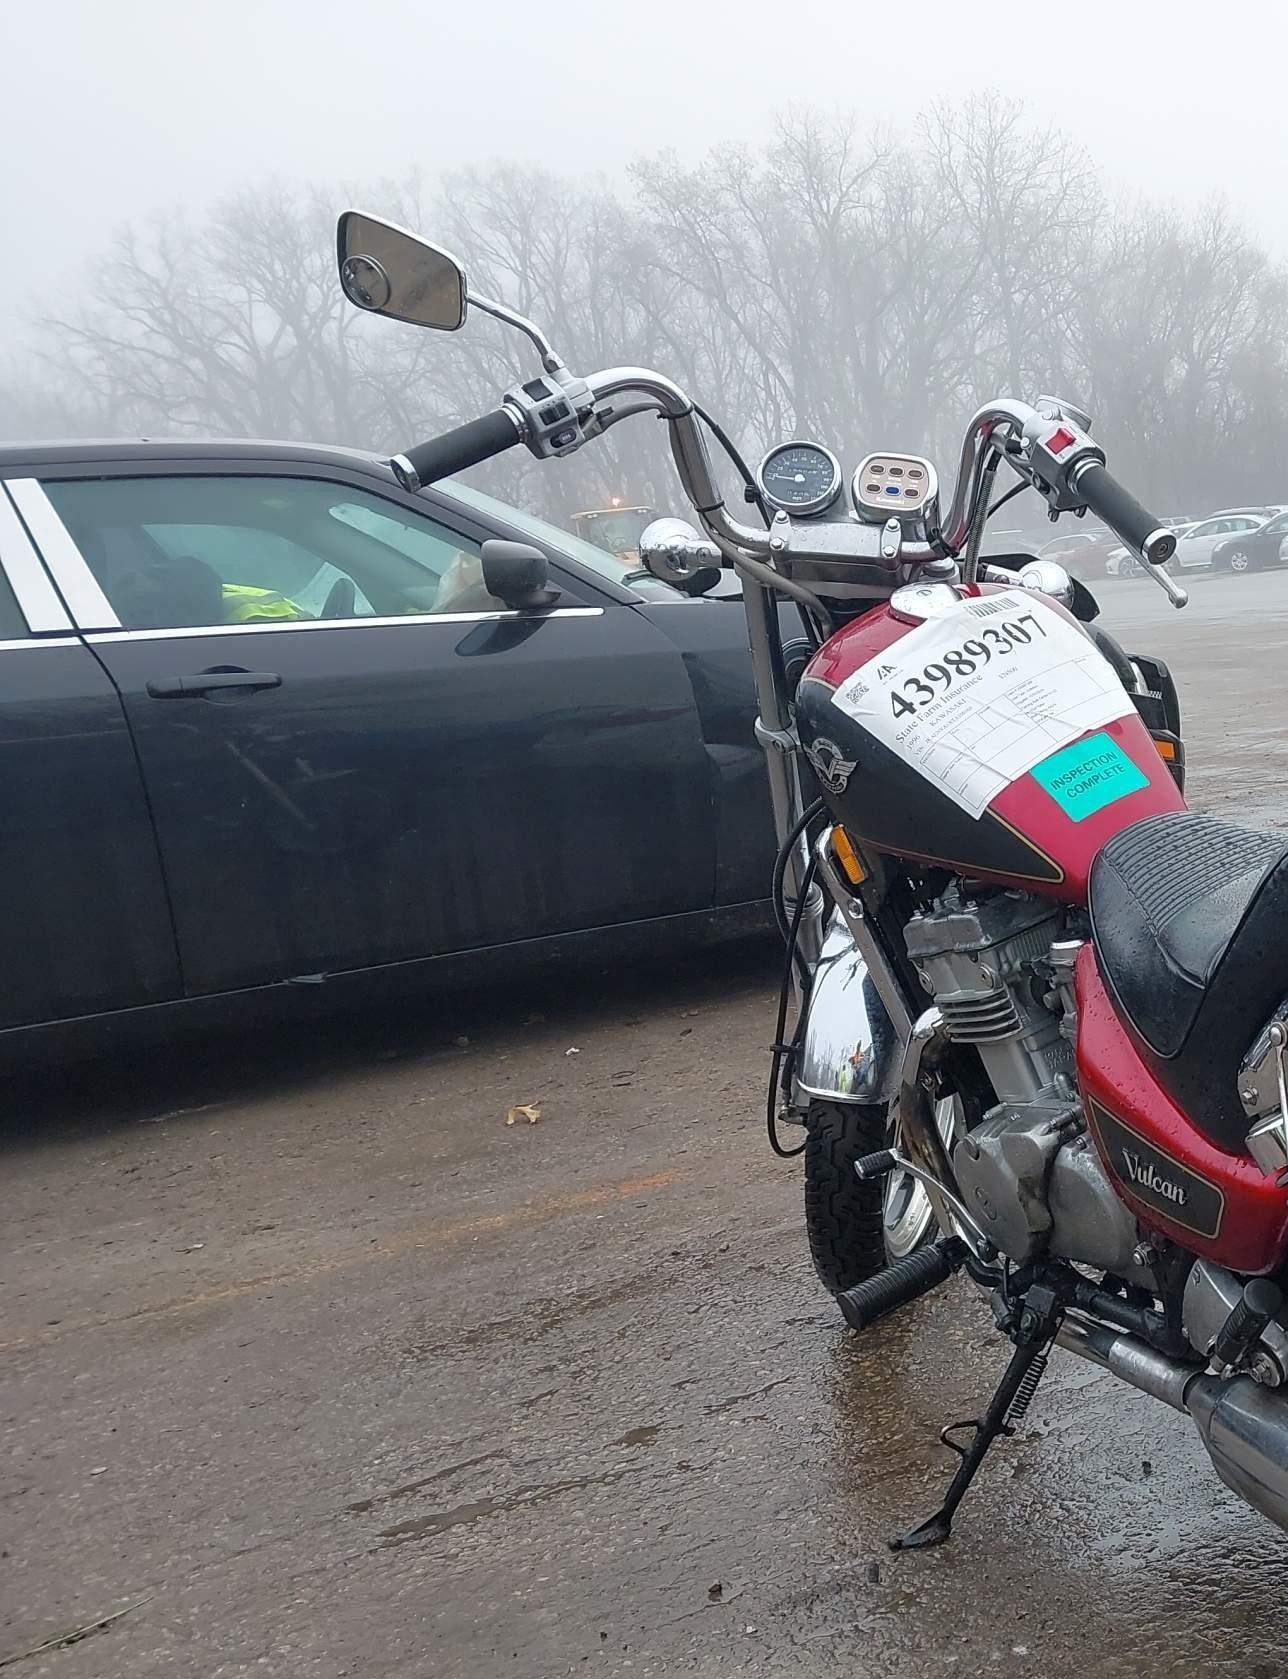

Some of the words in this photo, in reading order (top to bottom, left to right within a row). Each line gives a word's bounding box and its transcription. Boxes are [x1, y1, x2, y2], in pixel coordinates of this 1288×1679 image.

[890, 614, 1047, 720] 43989307
[895, 719, 919, 744] State
[917, 701, 942, 722] Farm
[939, 674, 983, 704] Insurance
[929, 698, 967, 727] KAWASAKI
[1050, 751, 1118, 791] INSPECTION
[1066, 763, 1126, 798] COMPLETE
[1122, 1148, 1187, 1205] Vulcan
